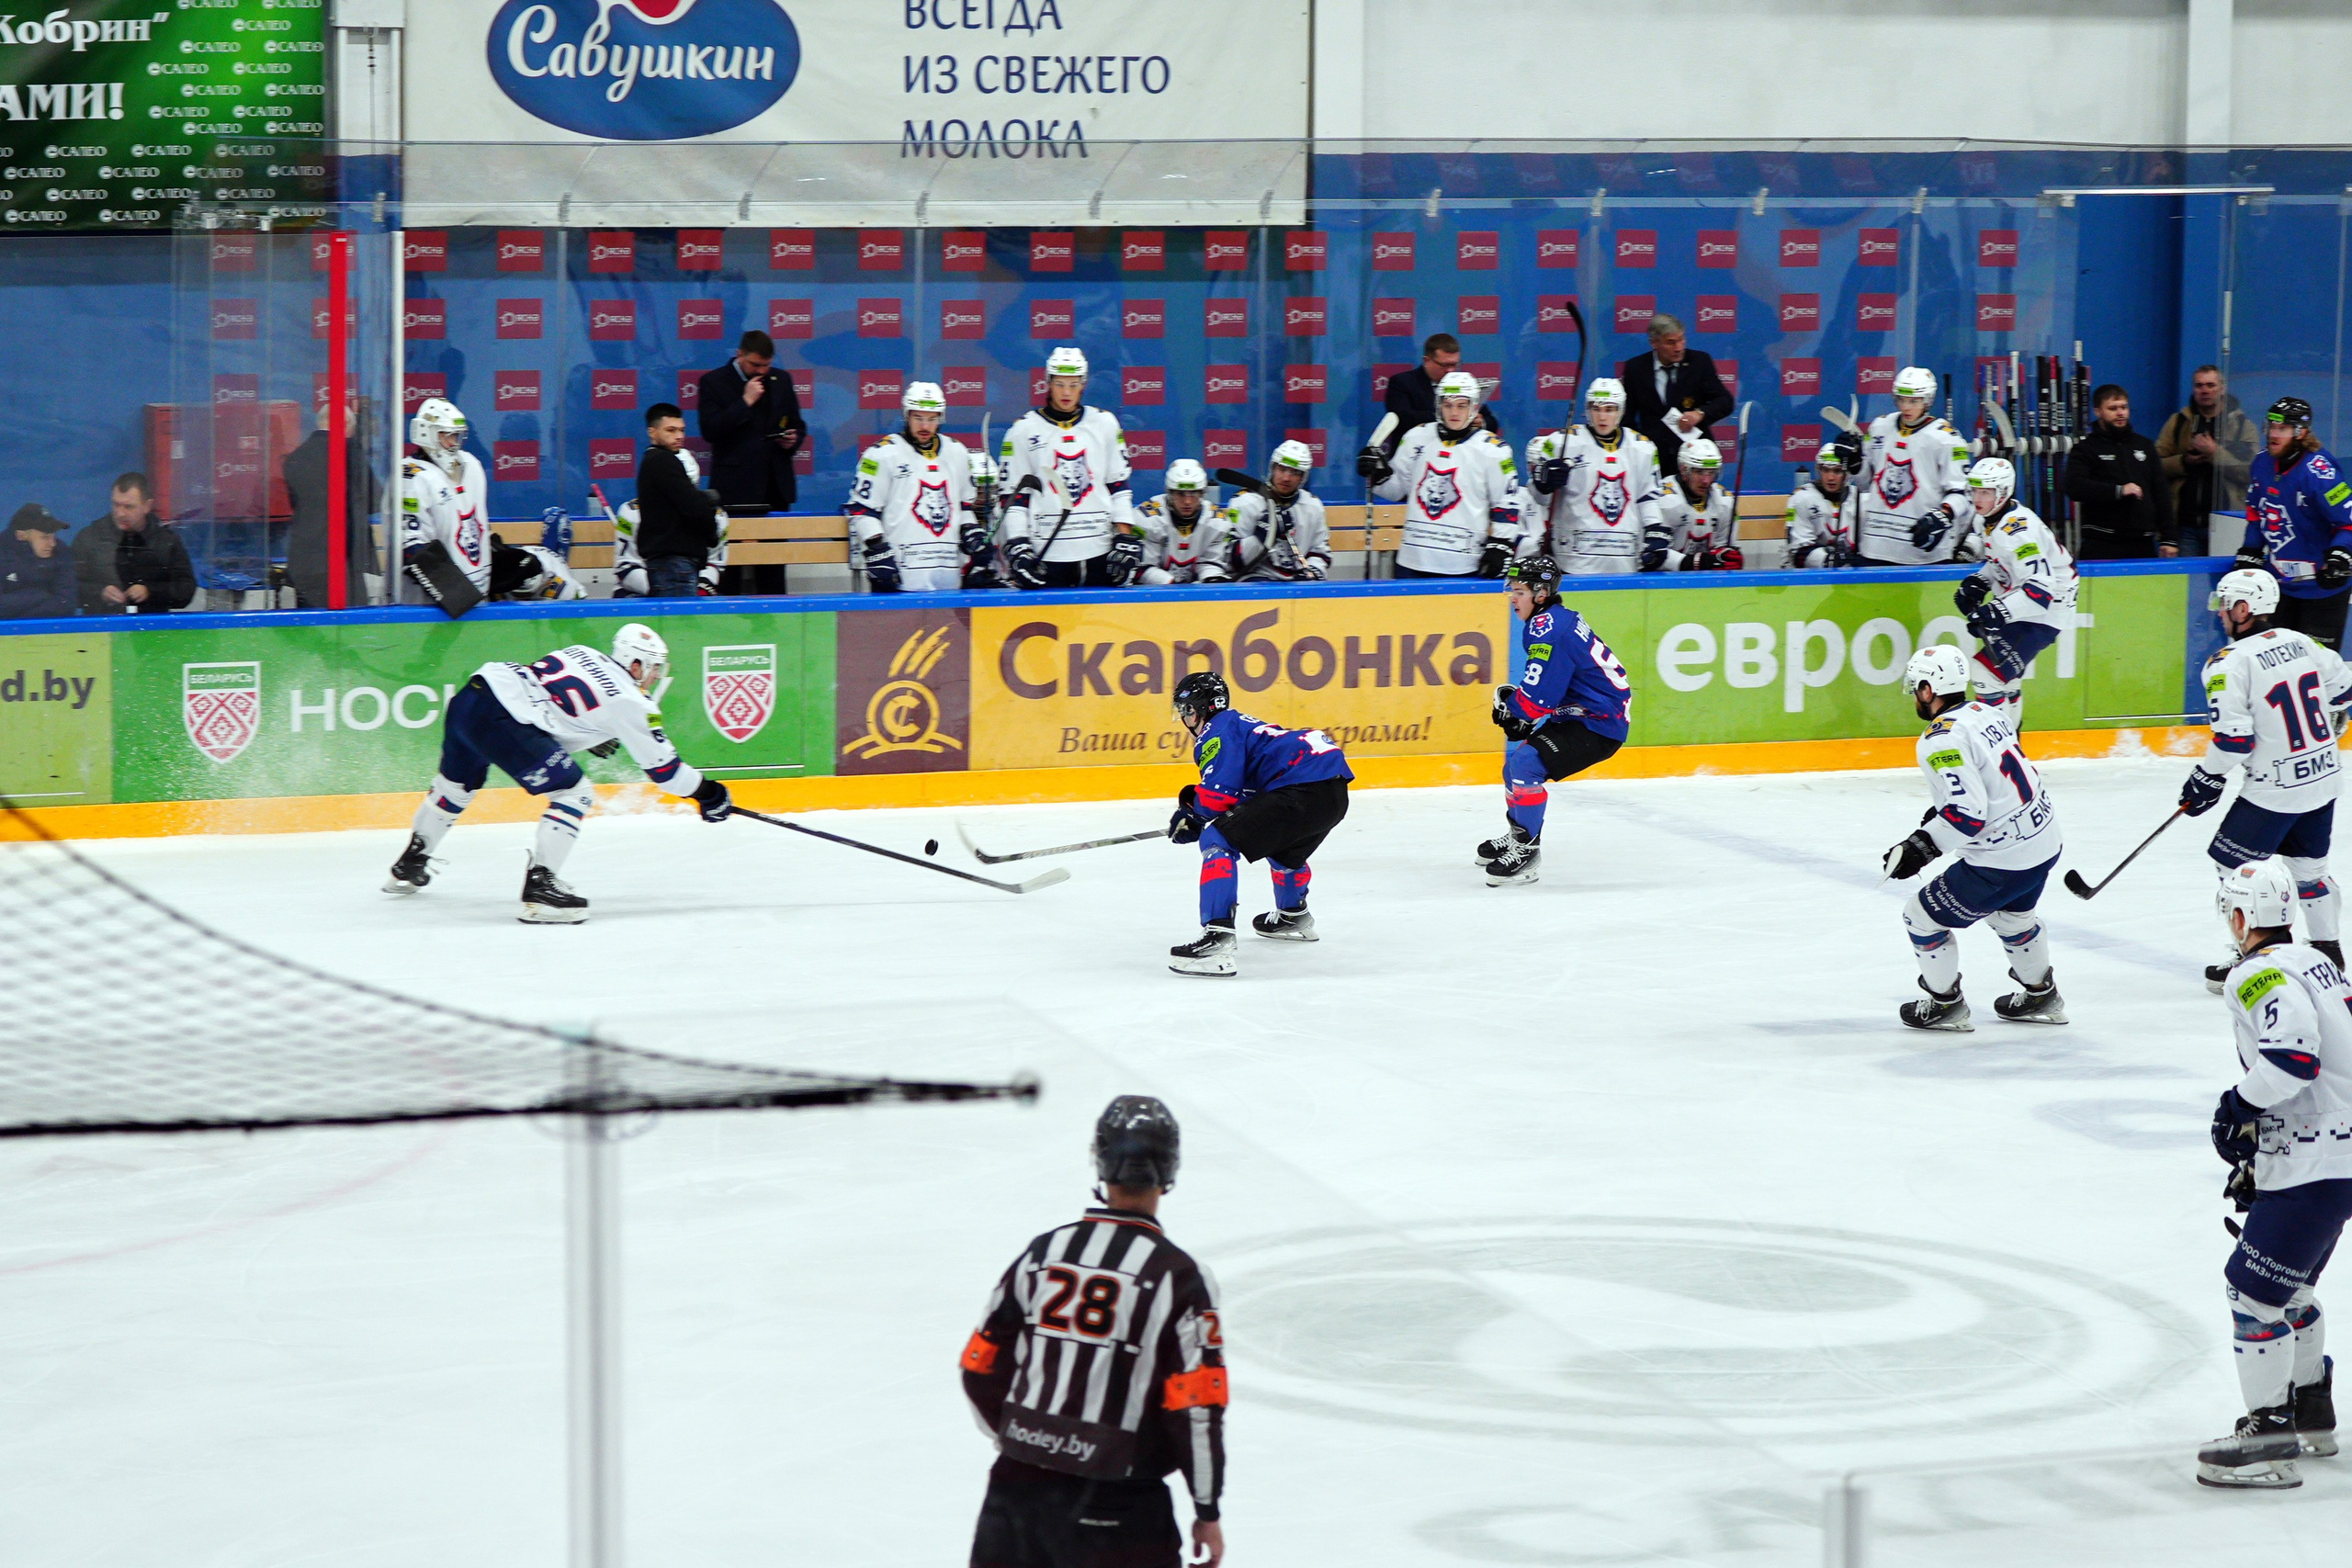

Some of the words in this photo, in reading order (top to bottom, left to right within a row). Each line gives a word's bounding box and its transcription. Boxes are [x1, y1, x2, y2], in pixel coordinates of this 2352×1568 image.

[903, 0, 1062, 38] ВСЕГДА
[507, 2, 776, 103] Савушкин
[901, 56, 957, 95] ИЗ
[974, 55, 1171, 95] СВЕЖЕГО
[900, 119, 1089, 159] МОЛОКА
[2025, 558, 2051, 577] 71
[710, 654, 770, 667] БЕЛАРУСЬ
[0, 669, 96, 709] d.by
[1214, 697, 1227, 709] 62
[2265, 671, 2331, 752] 16
[1059, 727, 1148, 753] Ваша
[2293, 750, 2335, 780] БМЗ
[2241, 973, 2283, 1004] BETERA
[2264, 998, 2279, 1030] 5
[1039, 1265, 1121, 1337] 28
